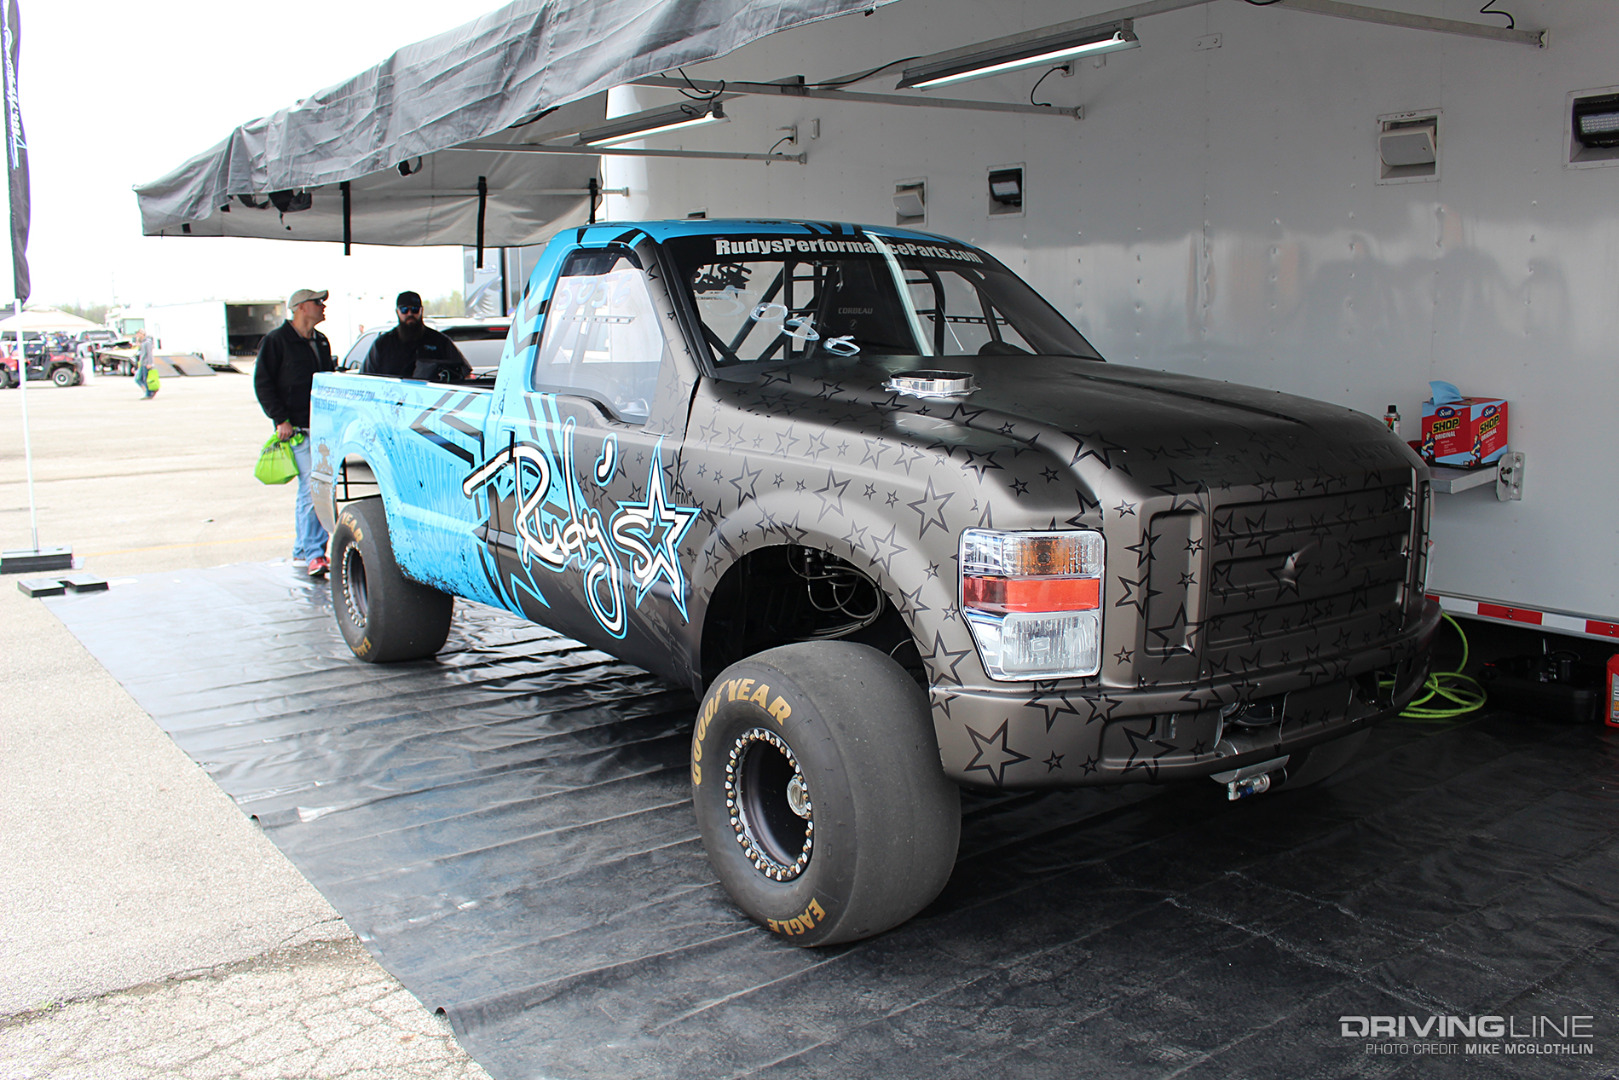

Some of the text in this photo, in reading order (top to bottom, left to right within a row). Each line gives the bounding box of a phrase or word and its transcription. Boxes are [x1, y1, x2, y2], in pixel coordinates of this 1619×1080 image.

[1439, 409, 1453, 417] Scott
[1433, 418, 1459, 433] SHOP
[1480, 414, 1500, 435] SHOP
[692, 678, 792, 786] GOODYEAR
[767, 897, 826, 936] EAGLE
